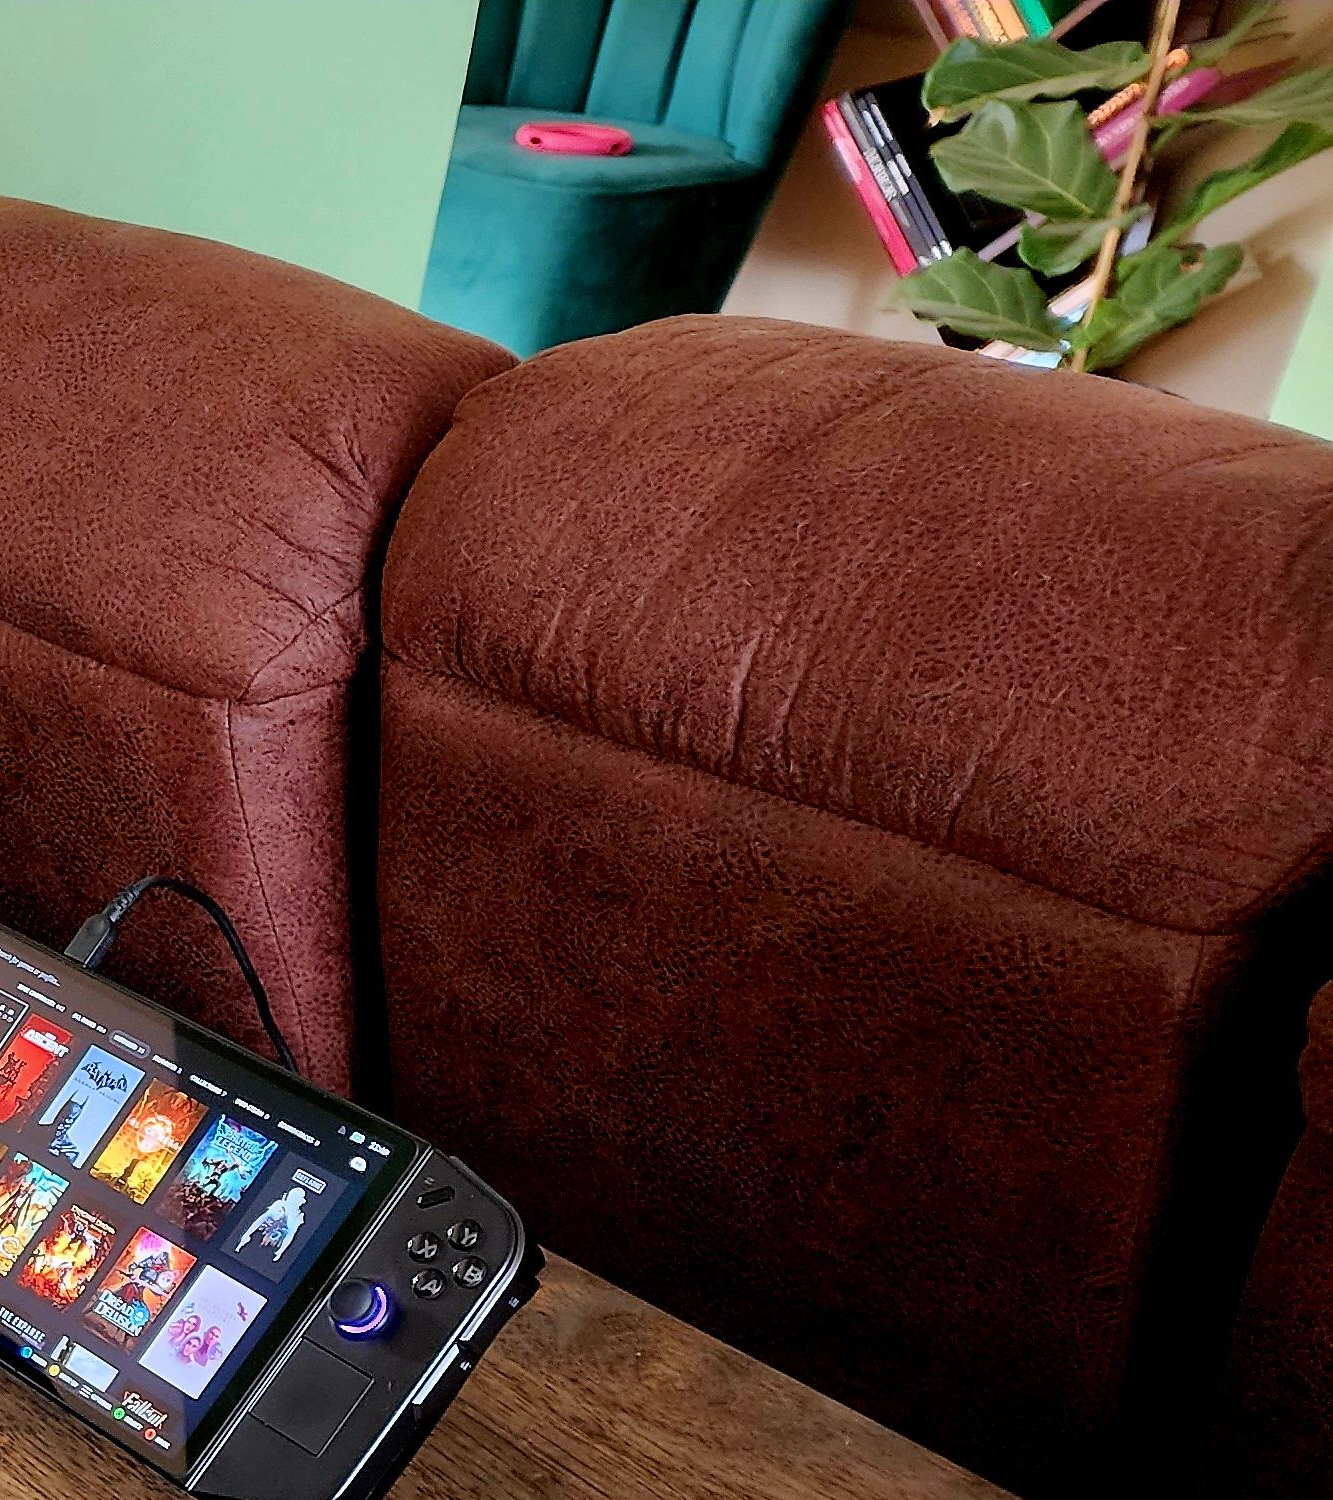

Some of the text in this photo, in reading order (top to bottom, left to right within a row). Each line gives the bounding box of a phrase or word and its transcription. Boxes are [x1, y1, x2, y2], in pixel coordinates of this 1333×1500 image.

[83, 1061, 128, 1092] BATMAN
[416, 1239, 438, 1258] X
[461, 1228, 478, 1247] Y
[463, 1265, 484, 1283] B
[421, 1280, 442, 1295] A
[98, 1289, 134, 1318] DREAD
[94, 1302, 143, 1337] DELUSION
[122, 1391, 168, 1429] Fallout
